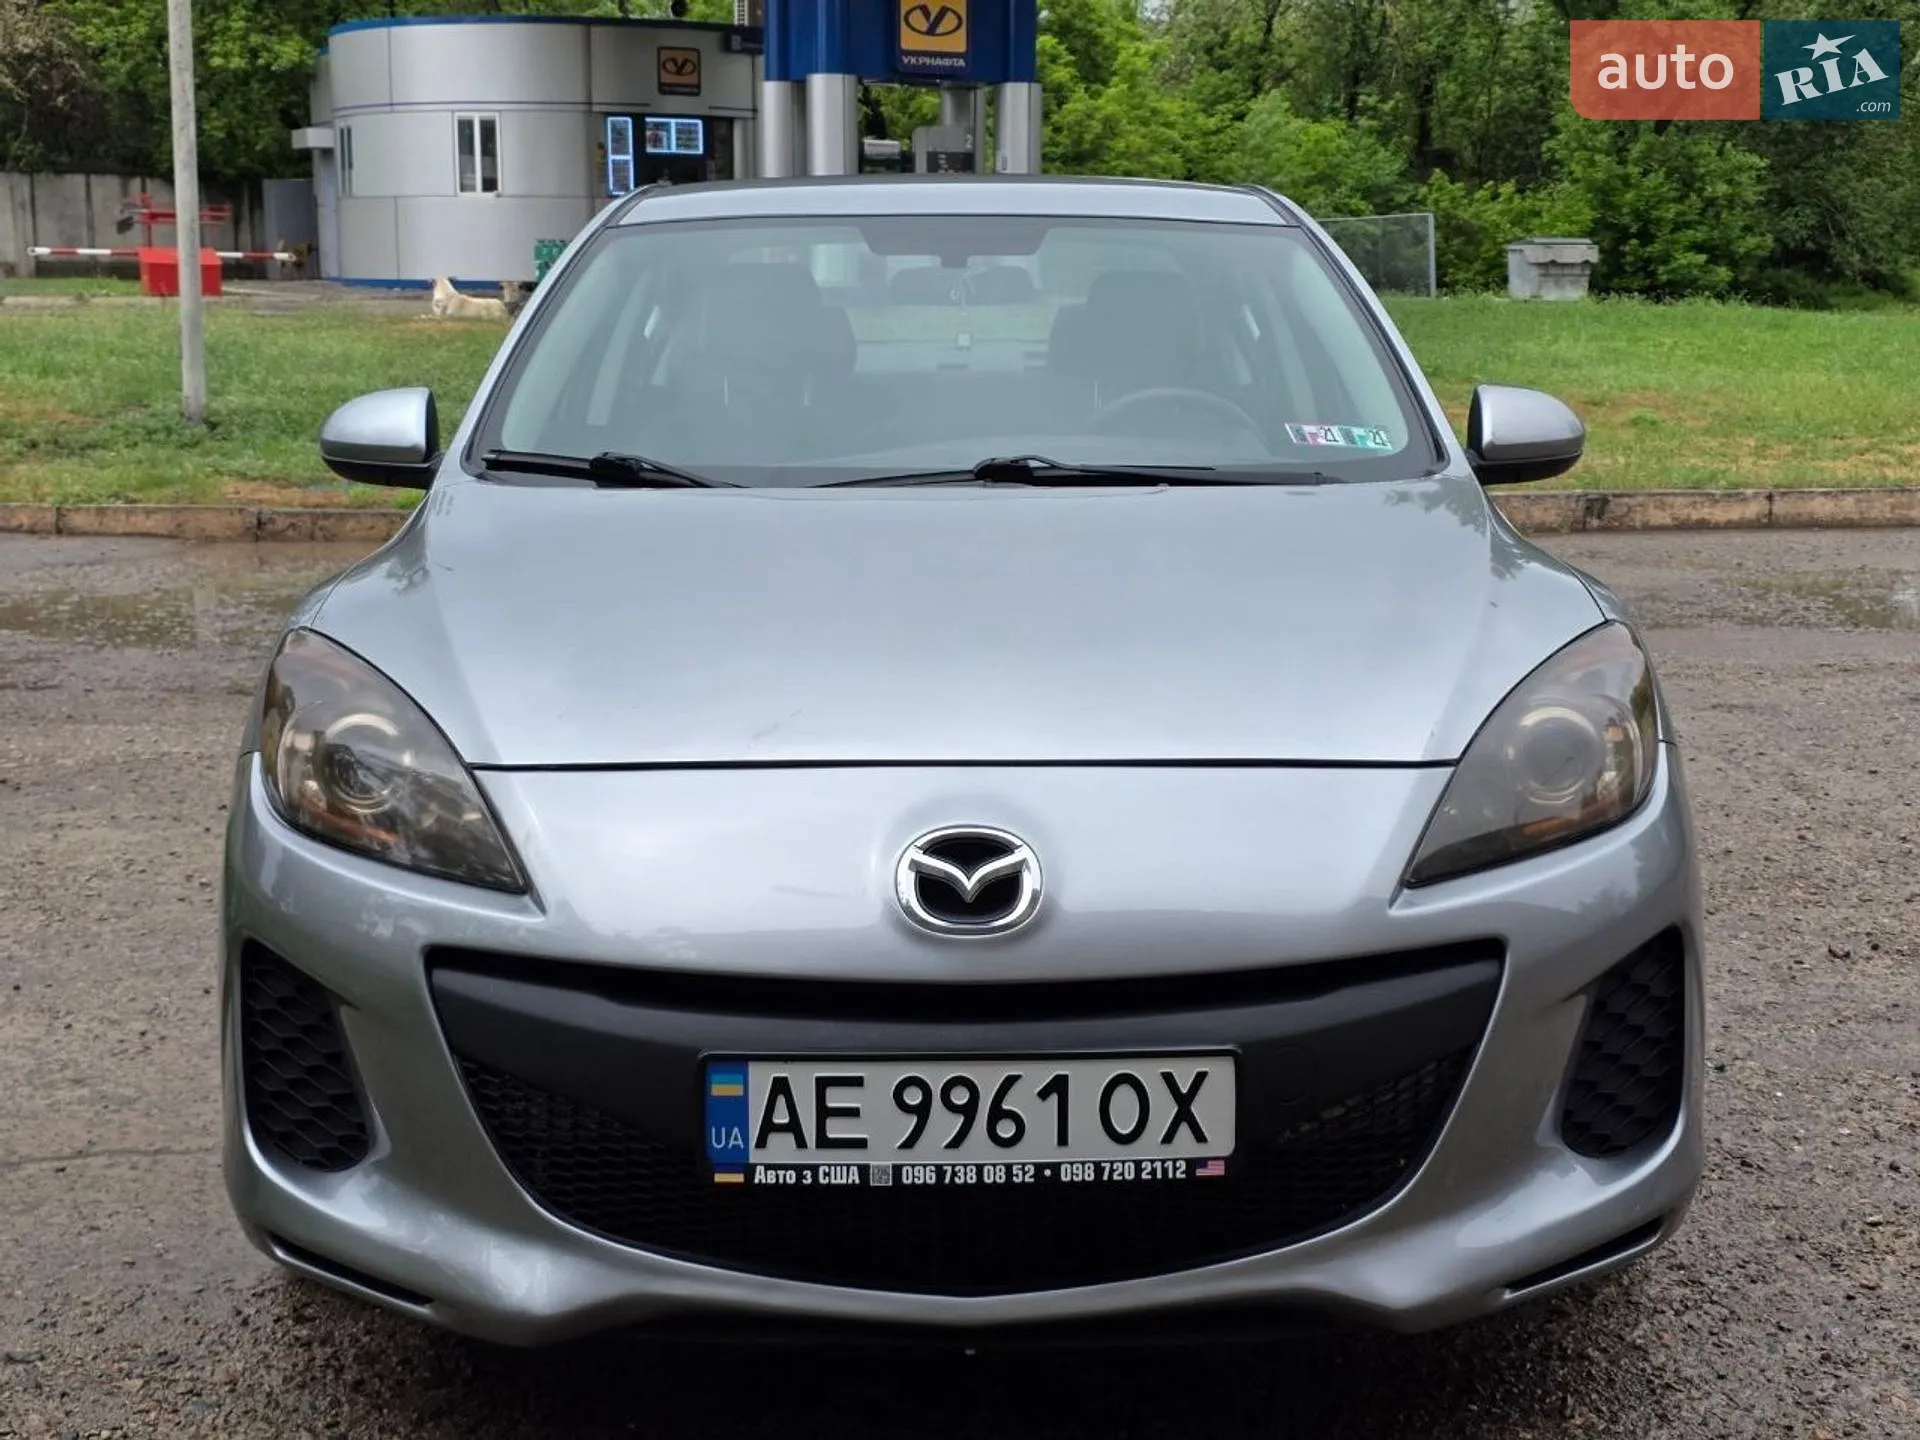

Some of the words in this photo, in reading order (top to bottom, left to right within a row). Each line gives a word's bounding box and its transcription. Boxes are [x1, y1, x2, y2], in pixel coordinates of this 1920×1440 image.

[901, 55, 966, 68] УКРНАФТА
[754, 1075, 868, 1150] AE
[892, 1073, 1069, 1150] 9961
[1098, 1070, 1209, 1146] OX
[711, 1126, 744, 1149] UA
[754, 1165, 796, 1185] Авто
[818, 1165, 860, 1185] США
[902, 1164, 938, 1185] 096
[943, 1164, 977, 1184] 738
[982, 1164, 1006, 1183] 08
[1011, 1163, 1036, 1183] 52
[1060, 1162, 1096, 1182] 098
[1101, 1161, 1135, 1181] 720
[1141, 1160, 1187, 1180] 2112
